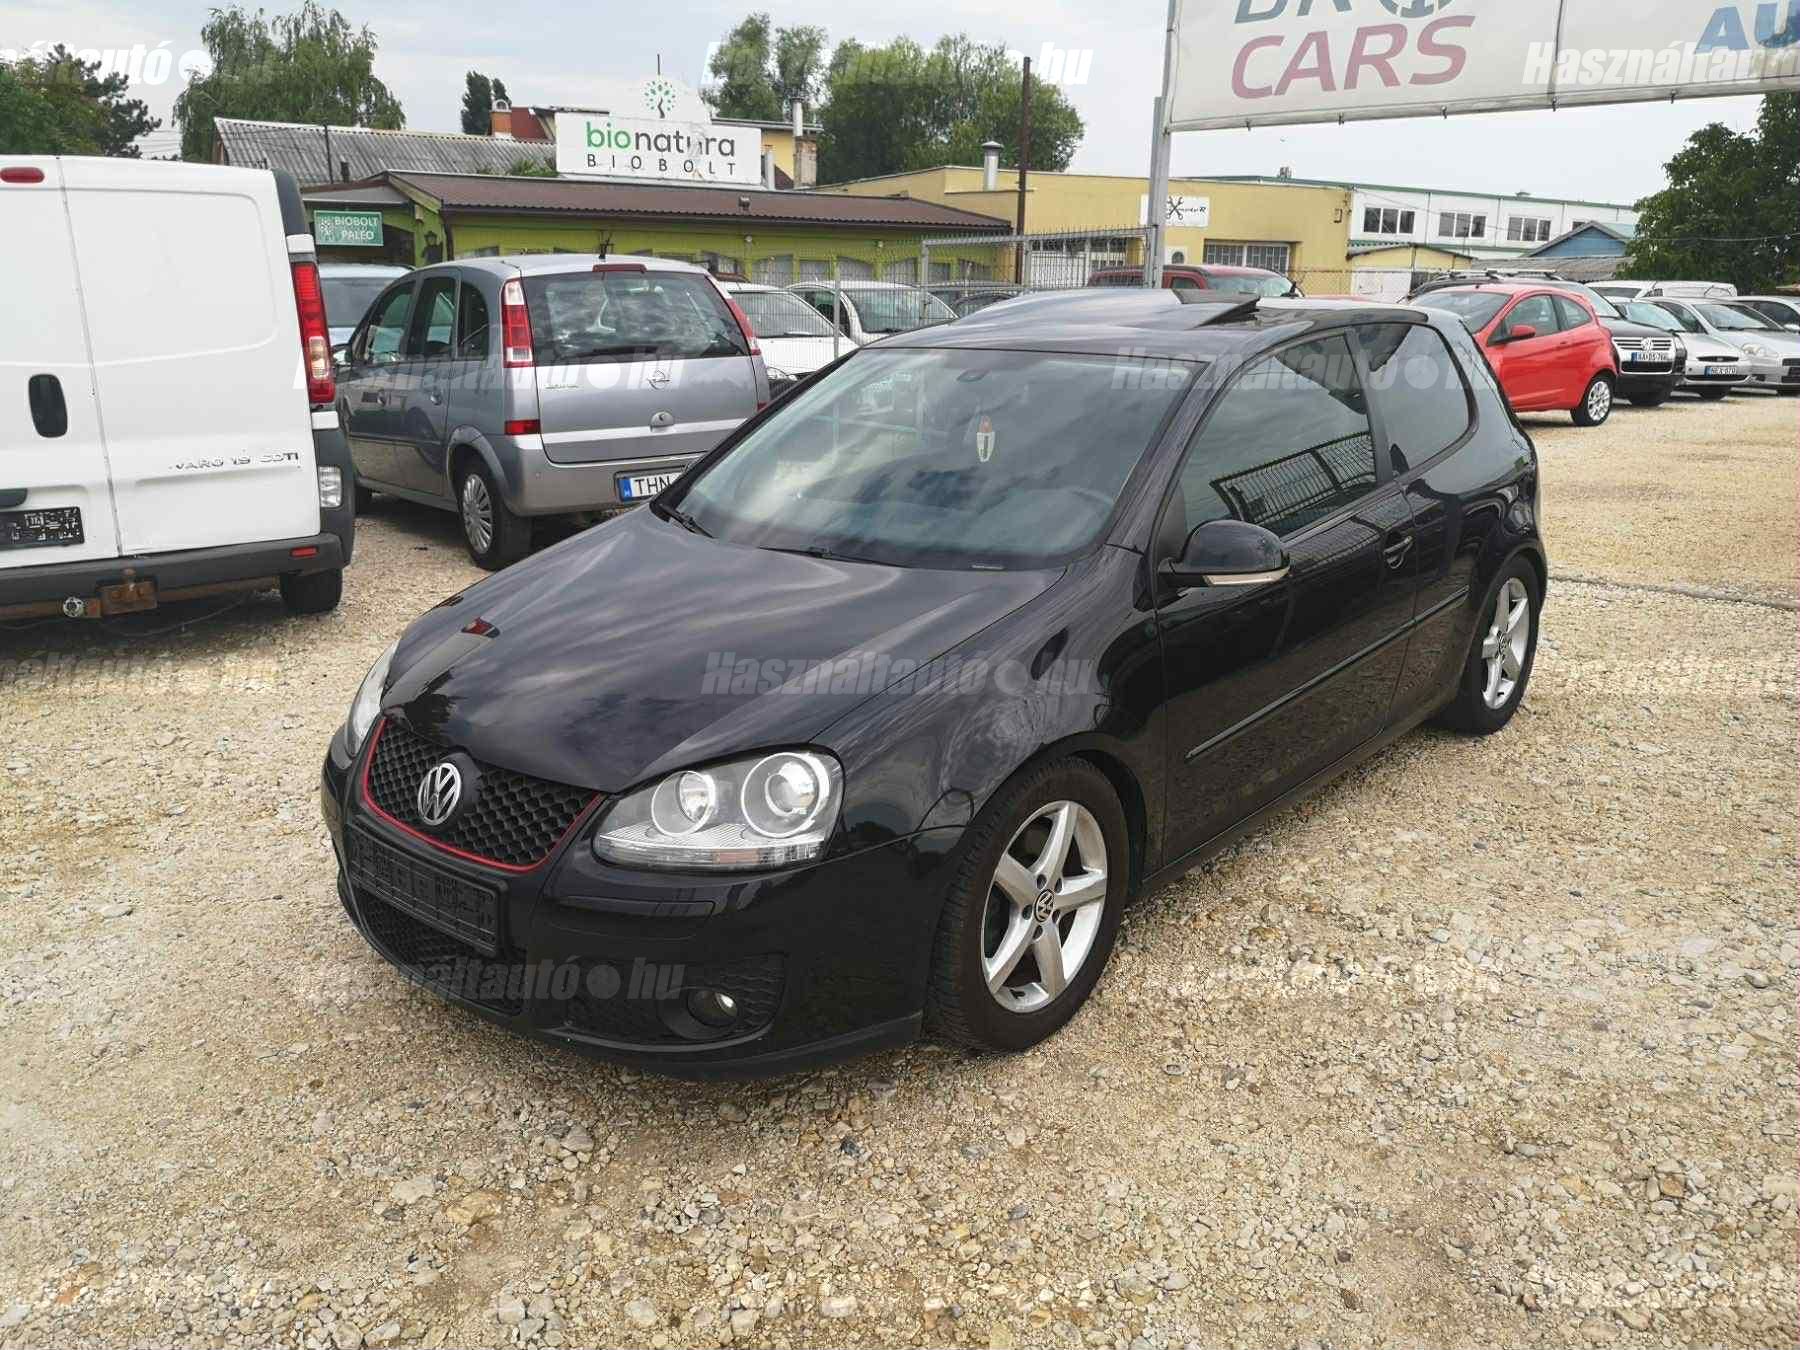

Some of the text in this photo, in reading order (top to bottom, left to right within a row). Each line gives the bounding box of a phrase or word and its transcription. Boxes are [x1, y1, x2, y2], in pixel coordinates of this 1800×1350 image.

[1231, 15, 1475, 99] CARS
[586, 121, 736, 158] bionatura
[587, 154, 736, 176] BIOBOLT
[334, 216, 379, 226] BIOBOLT
